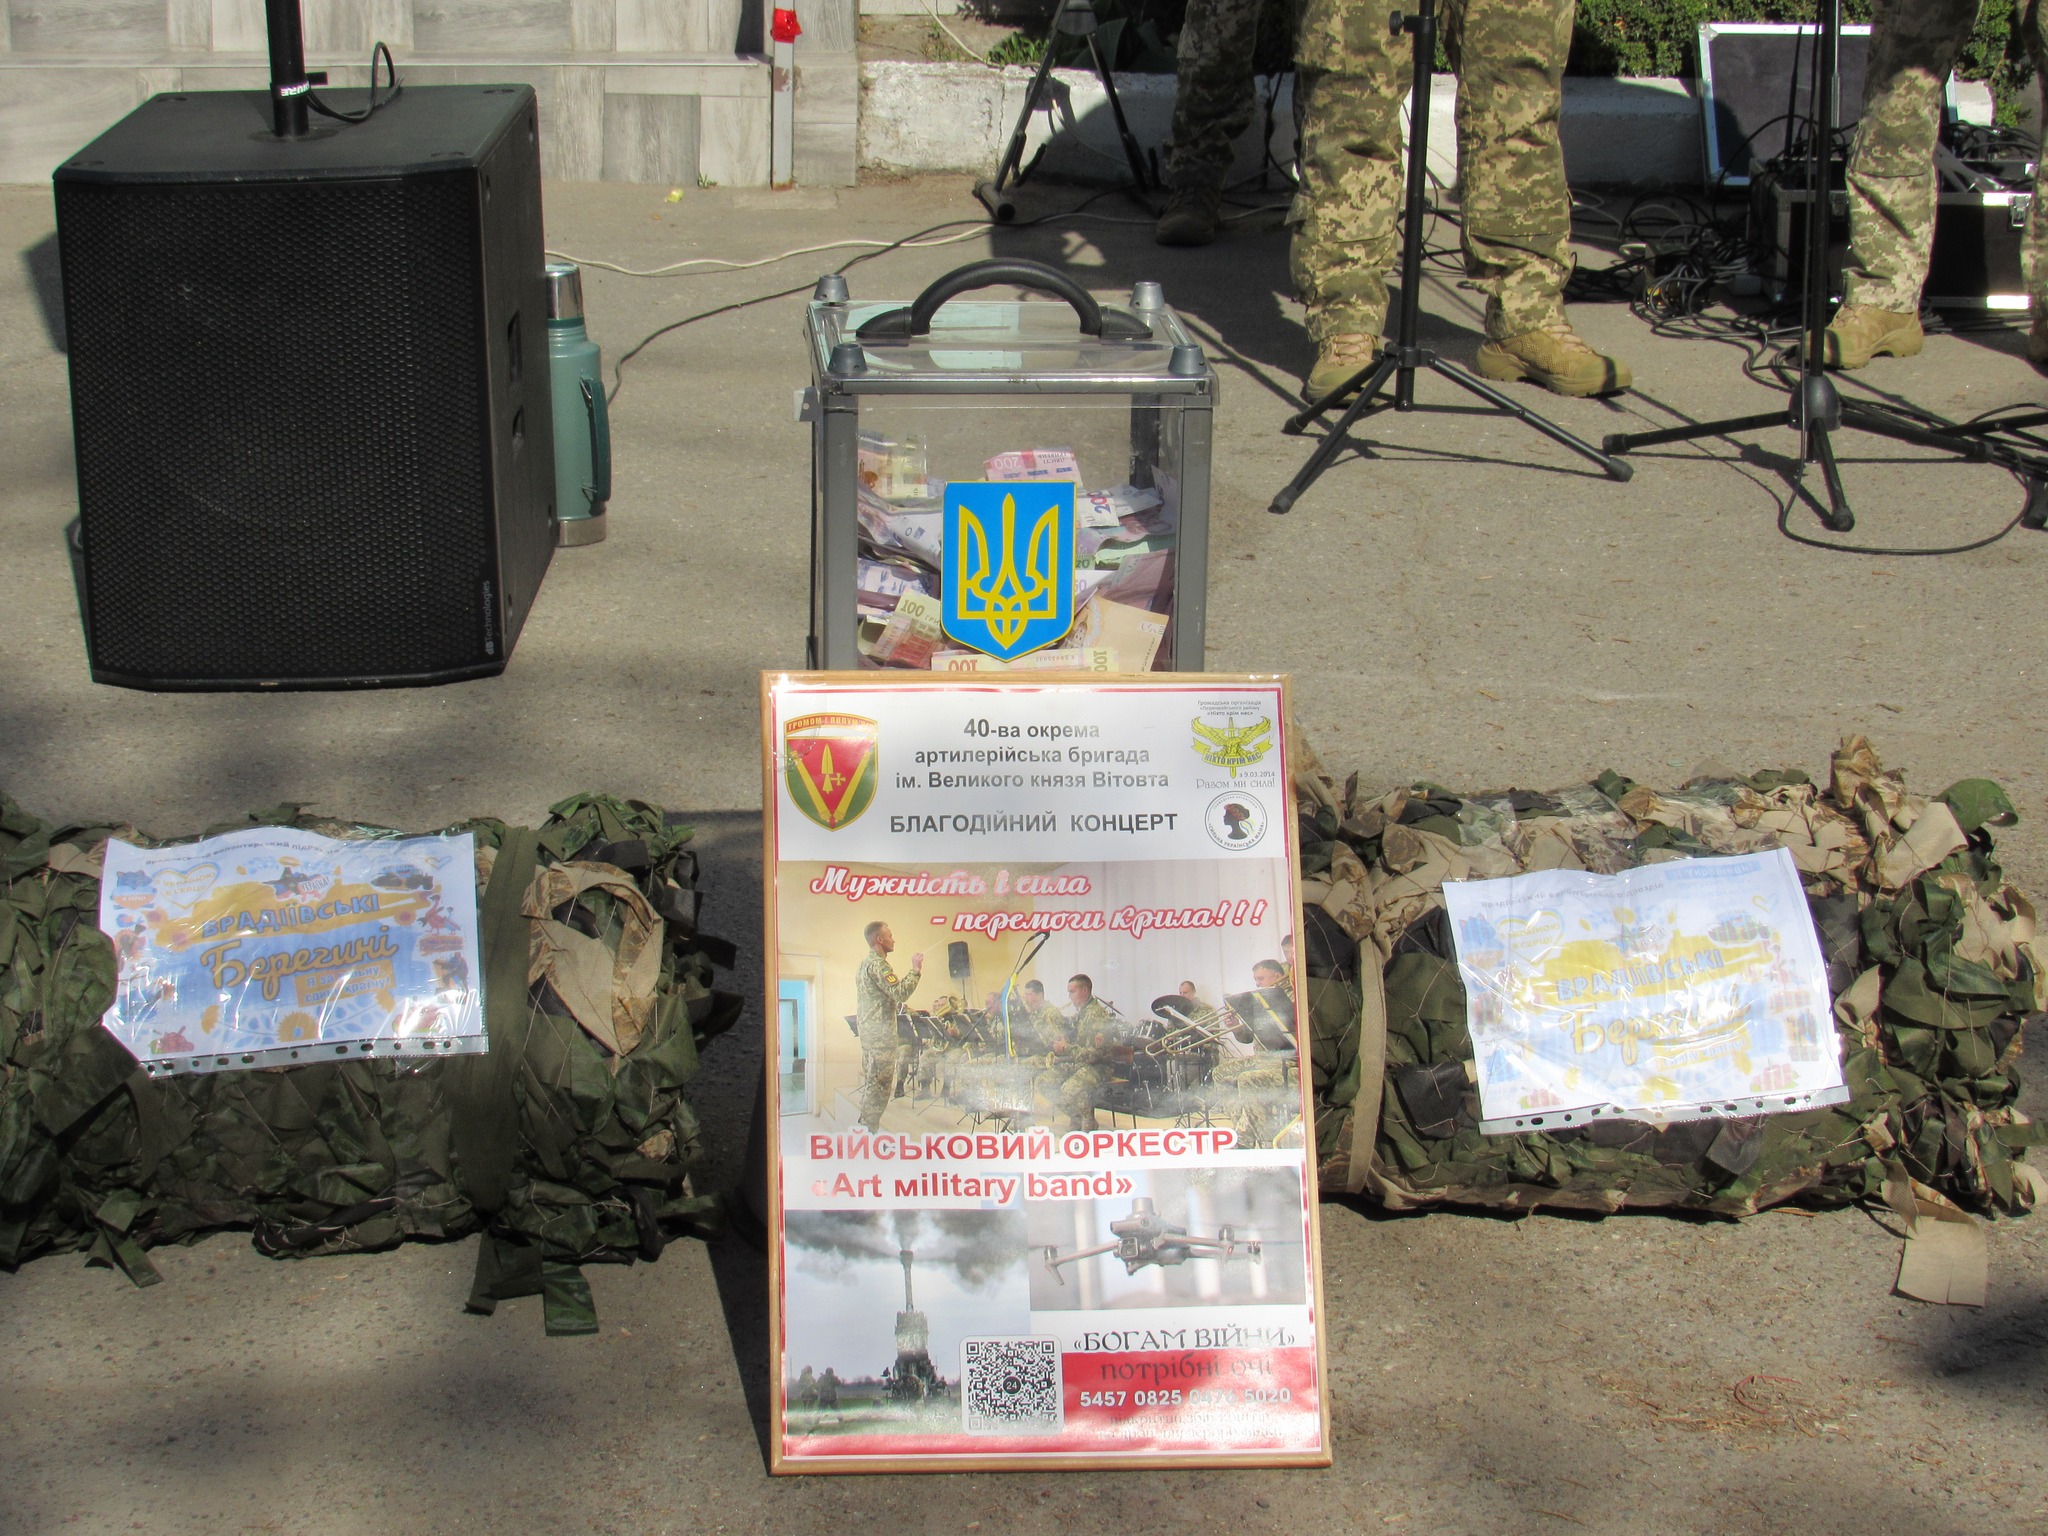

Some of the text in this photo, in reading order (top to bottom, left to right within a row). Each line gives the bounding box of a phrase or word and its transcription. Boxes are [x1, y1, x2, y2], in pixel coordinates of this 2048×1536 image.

[994, 456, 1021, 471] 200
[482, 580, 495, 656] dBTechnologies
[900, 599, 925, 617] 100
[788, 717, 821, 730] ГРОМОМ
[963, 718, 1101, 743] 40-ва окрема
[914, 746, 1150, 767] артилерійська бригада
[1204, 752, 1262, 765] НІХТО КРІМ НАС
[895, 770, 1170, 793] ім. Великого князя Вітовта
[1196, 778, 1276, 789] Разом ми сила!
[889, 812, 1178, 837] БЛАГОДІЙНИЙ КОНЦЕРТ
[811, 866, 985, 901] Мужність
[1016, 875, 1091, 896] сила
[202, 893, 380, 938] ВРАДІЇВСЬКІ
[952, 911, 1105, 940] перемоги
[1108, 900, 1268, 940] крила!!!
[200, 925, 399, 1001] Берегині
[1556, 949, 1724, 1001] ВРАДІЇВСЬКІ
[319, 974, 334, 985] за
[810, 1128, 1235, 1160] ВІЙСЬКОВИЙ ОРКЕСТР
[811, 1172, 882, 1198] «Art
[1028, 1171, 1133, 1198] band»
[1073, 1323, 1296, 1351] «БОГАМ ВІЙНИ»
[1100, 1352, 1272, 1386] потрібні очі
[1006, 1381, 1018, 1390] 24
[1080, 1391, 1127, 1407] 5457
[1134, 1390, 1182, 1406] 0825
[1244, 1387, 1293, 1404] 5020
